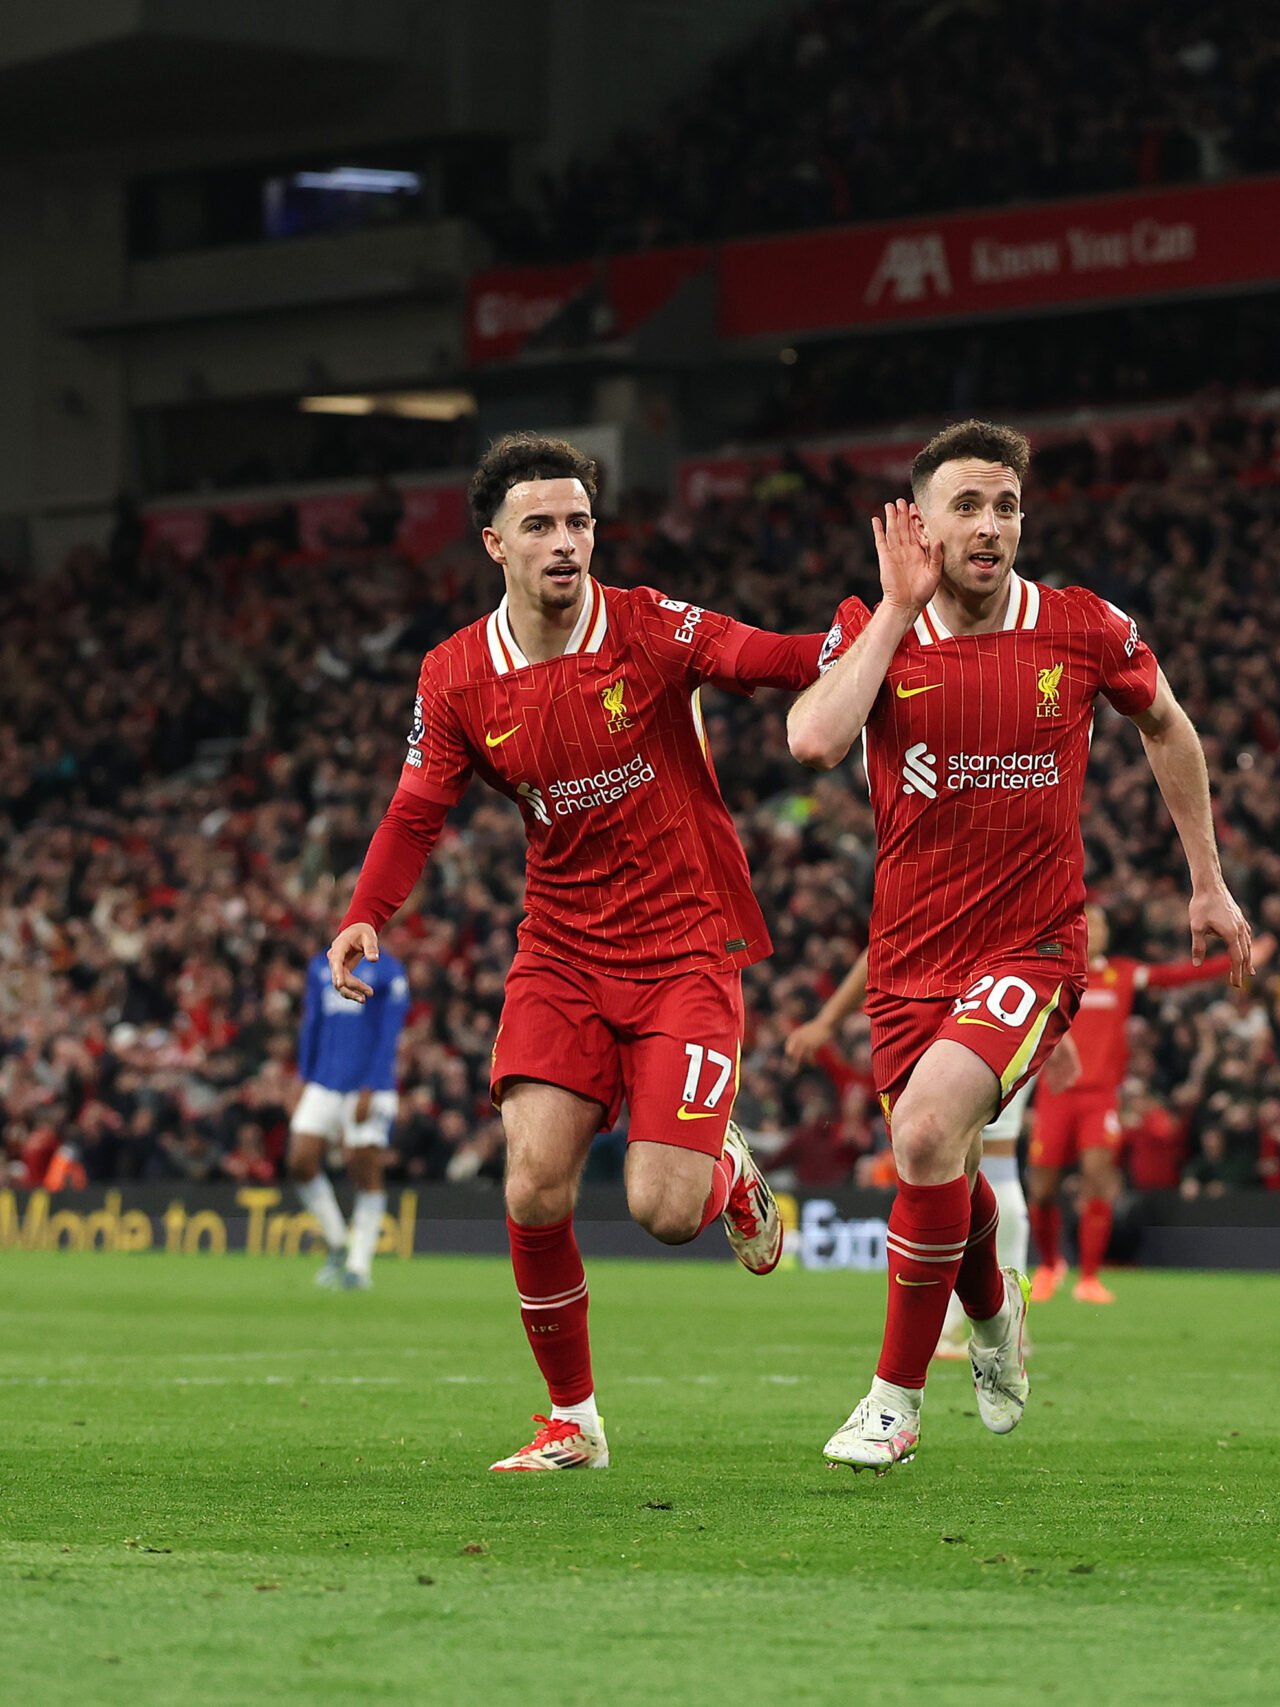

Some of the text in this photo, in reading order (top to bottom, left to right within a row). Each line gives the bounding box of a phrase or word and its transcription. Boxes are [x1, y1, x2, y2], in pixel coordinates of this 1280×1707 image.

[548, 753, 644, 798] standard
[947, 750, 1057, 771] standard
[947, 766, 1060, 790] chartered
[555, 763, 656, 815] chartered
[951, 974, 1037, 1027] 20
[682, 1042, 732, 1108] 17
